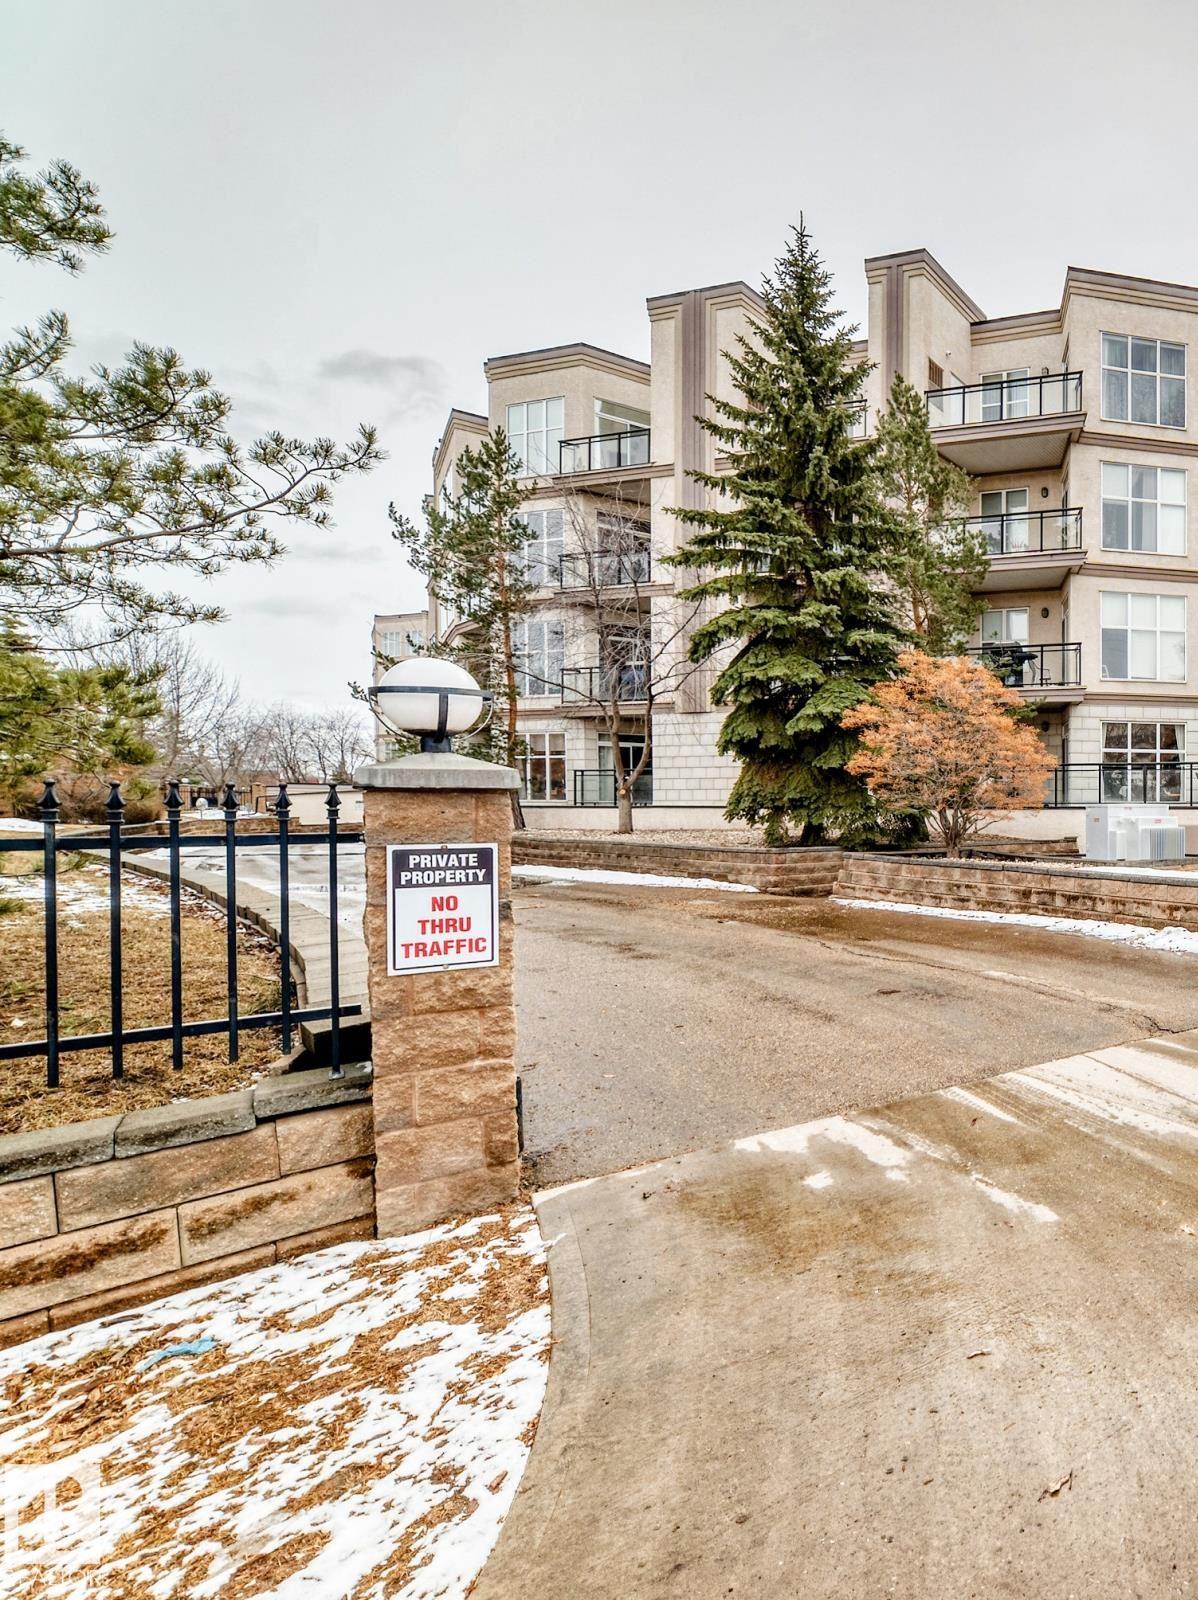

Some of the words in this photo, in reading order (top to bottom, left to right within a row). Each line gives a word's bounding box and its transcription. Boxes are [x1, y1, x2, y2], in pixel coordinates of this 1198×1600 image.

[409, 853, 478, 868] PRIVATE
[400, 868, 487, 885] PROPERTY
[431, 895, 458, 912] NO
[417, 916, 472, 935] THRU
[400, 937, 487, 959] TRAFFIC
